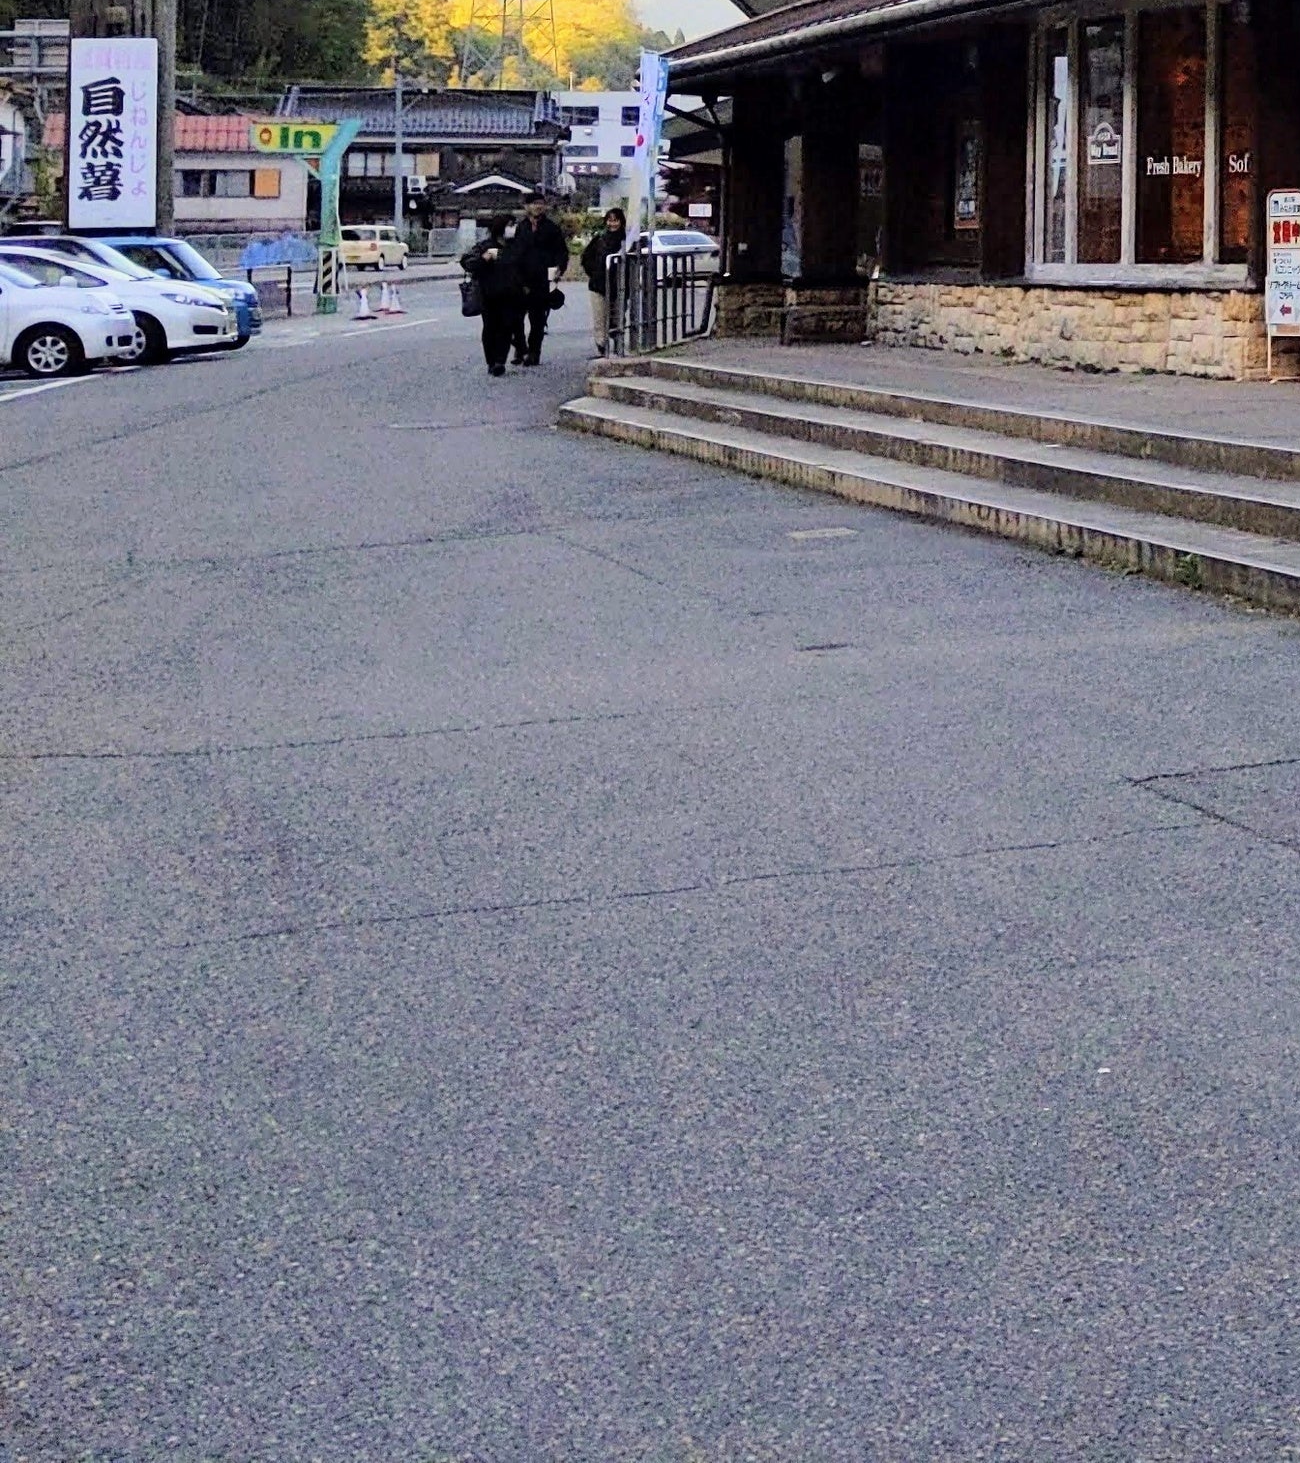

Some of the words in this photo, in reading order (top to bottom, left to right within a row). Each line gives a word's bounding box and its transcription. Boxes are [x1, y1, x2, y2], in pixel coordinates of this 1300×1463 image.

[78, 76, 126, 202] 自然薯
[1147, 156, 1169, 175] Fresh
[1173, 155, 1201, 177] Bakery
